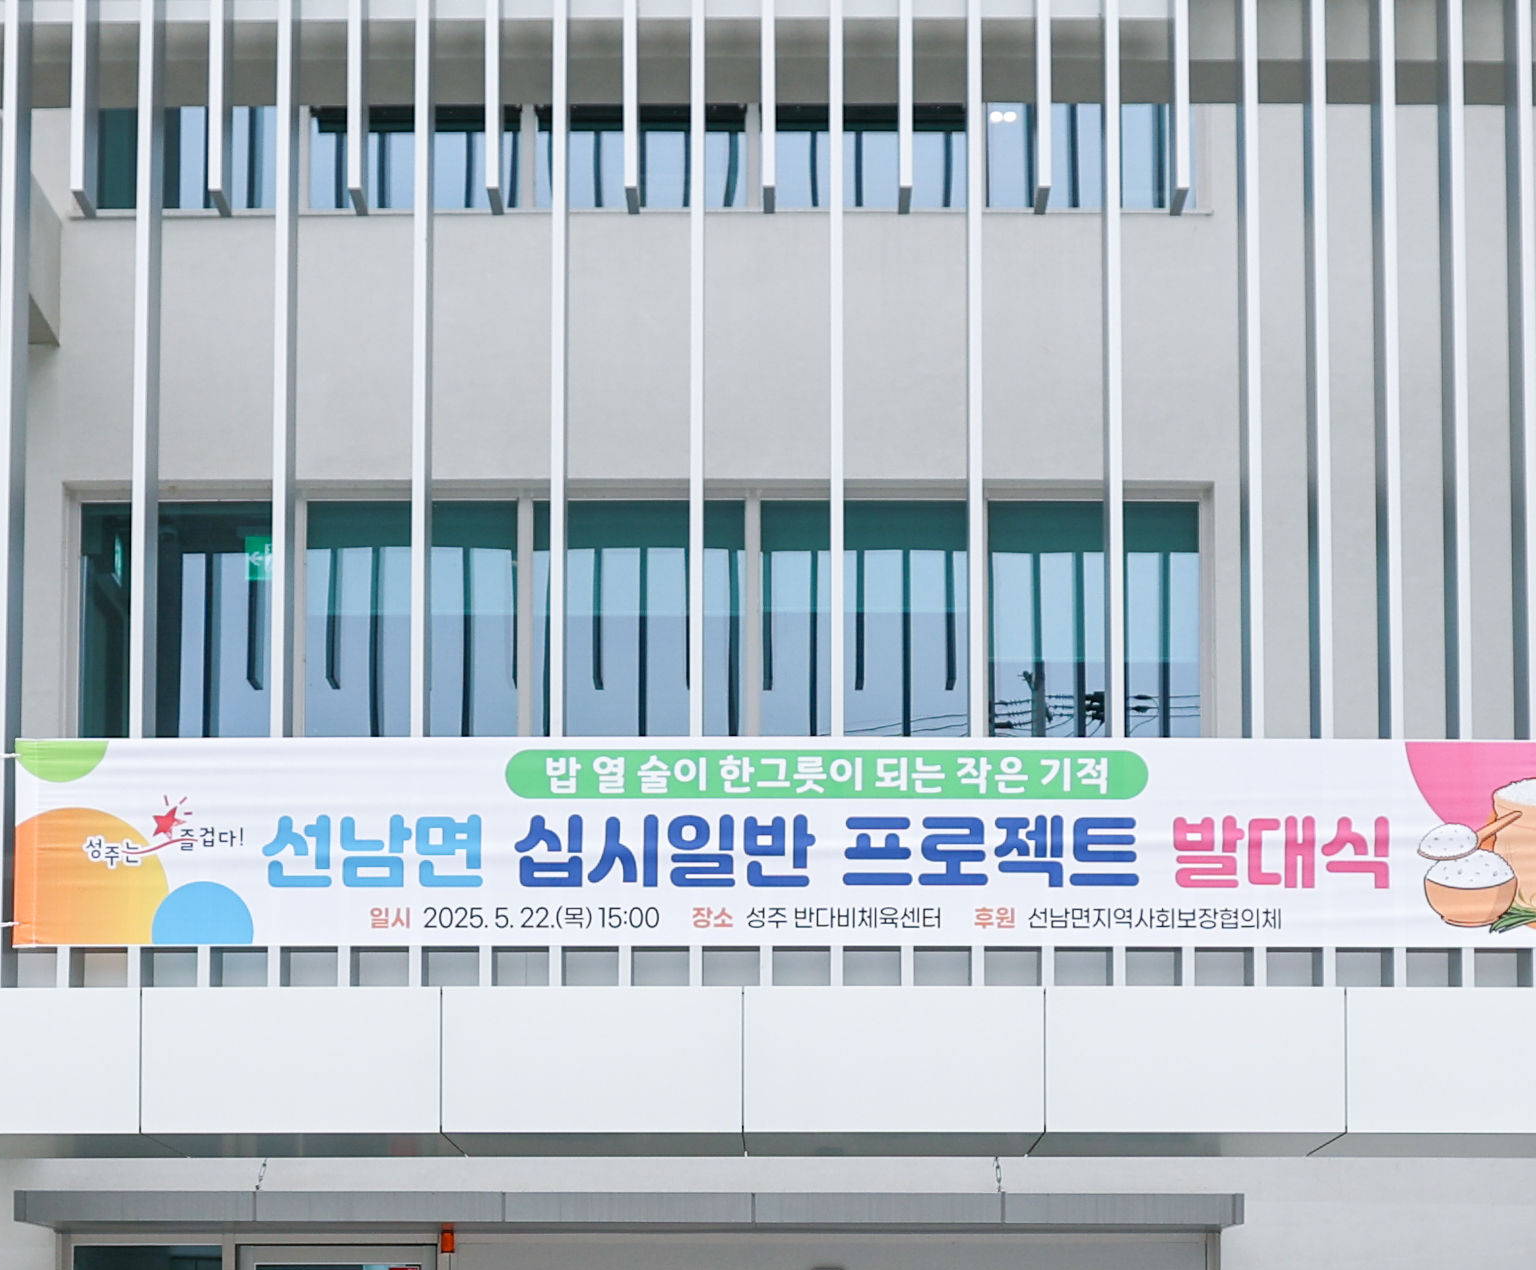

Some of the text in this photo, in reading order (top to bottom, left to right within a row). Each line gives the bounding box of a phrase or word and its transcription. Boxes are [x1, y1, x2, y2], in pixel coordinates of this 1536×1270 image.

[545, 755, 1109, 795] 밥 열 술이 한그릇이 되는 작은 기적
[84, 826, 244, 867] 성주는 즐겁다!
[262, 814, 1391, 889] 선남면 십시일반 프로젝트 발대식
[370, 905, 1282, 930] 일시 2025. 5. 22.(목) 15:00 장소 성주 반다비체육센터 후원 선남면지역사회보장협의체
